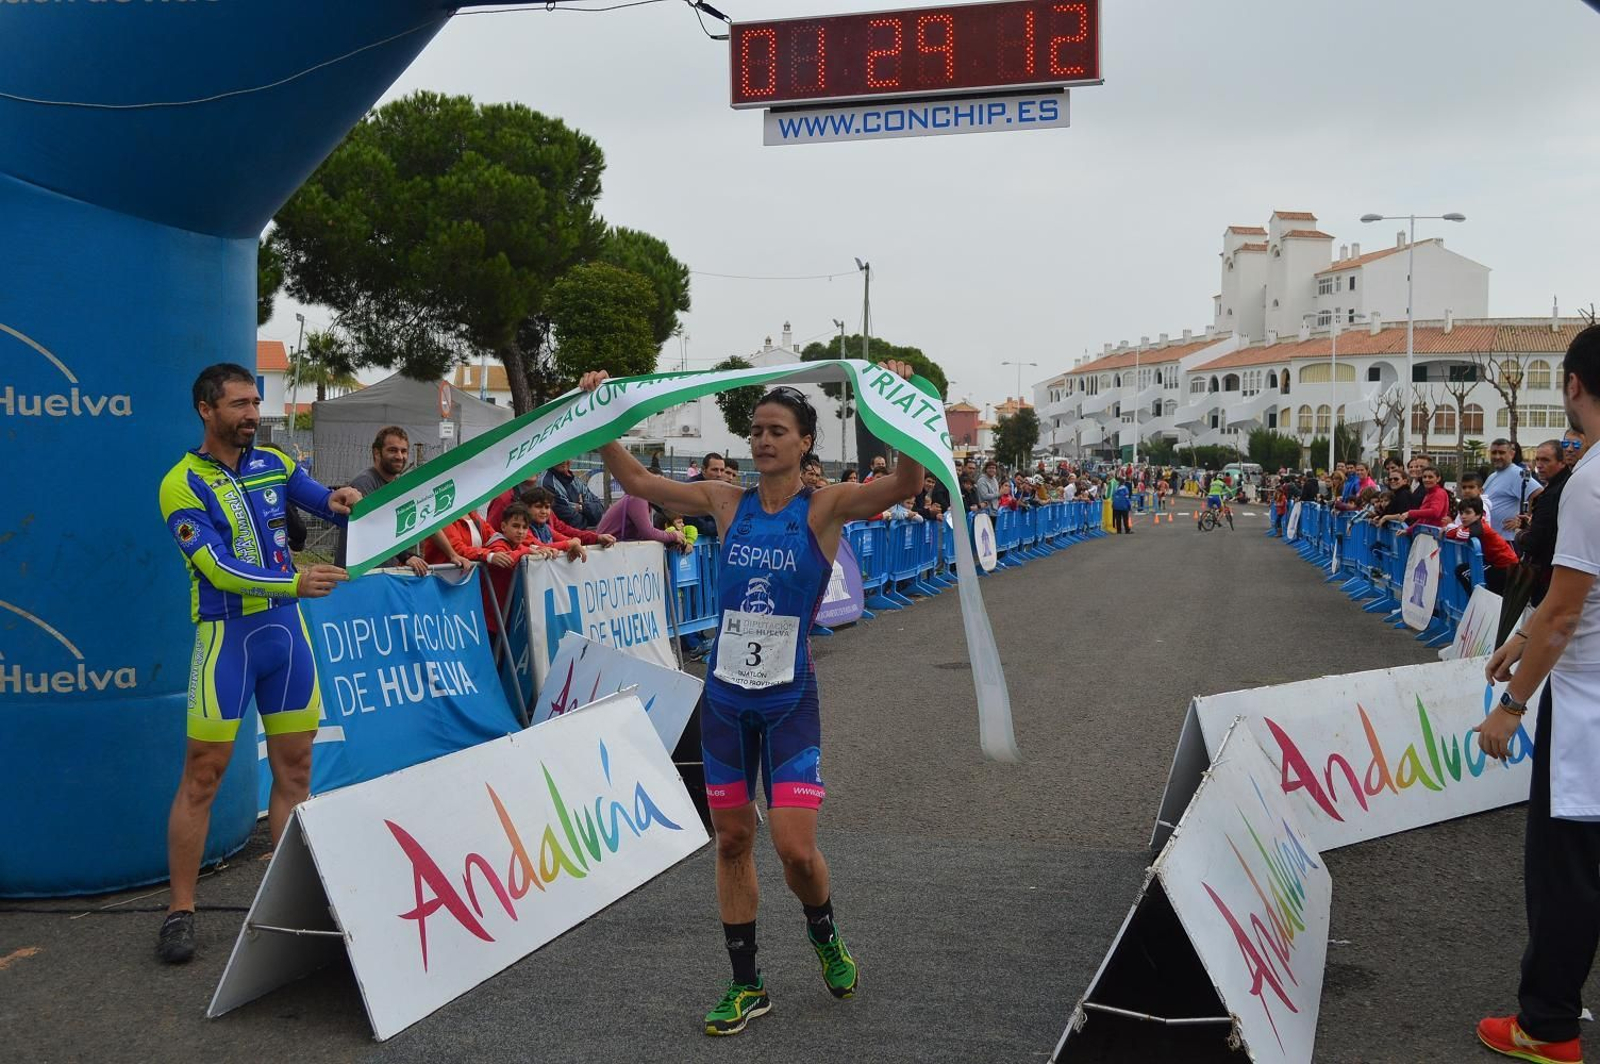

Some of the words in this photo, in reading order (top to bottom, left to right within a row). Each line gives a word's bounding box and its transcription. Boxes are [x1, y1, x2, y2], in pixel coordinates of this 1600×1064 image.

[867, 14, 953, 88] 29
[1026, 4, 1088, 75] 12
[778, 99, 1058, 139] WWW.CONCHIP.ES
[727, 543, 797, 572] ESPADA
[584, 567, 662, 613] DIPUTACIÓN
[322, 608, 481, 663] DIPUTACIÓN
[609, 610, 661, 650] HUELVA
[745, 642, 762, 667] 3
[0, 663, 138, 694] Huelva
[334, 672, 376, 717] DE
[377, 660, 479, 708] HUELVA
[383, 737, 685, 974] Andalucía
